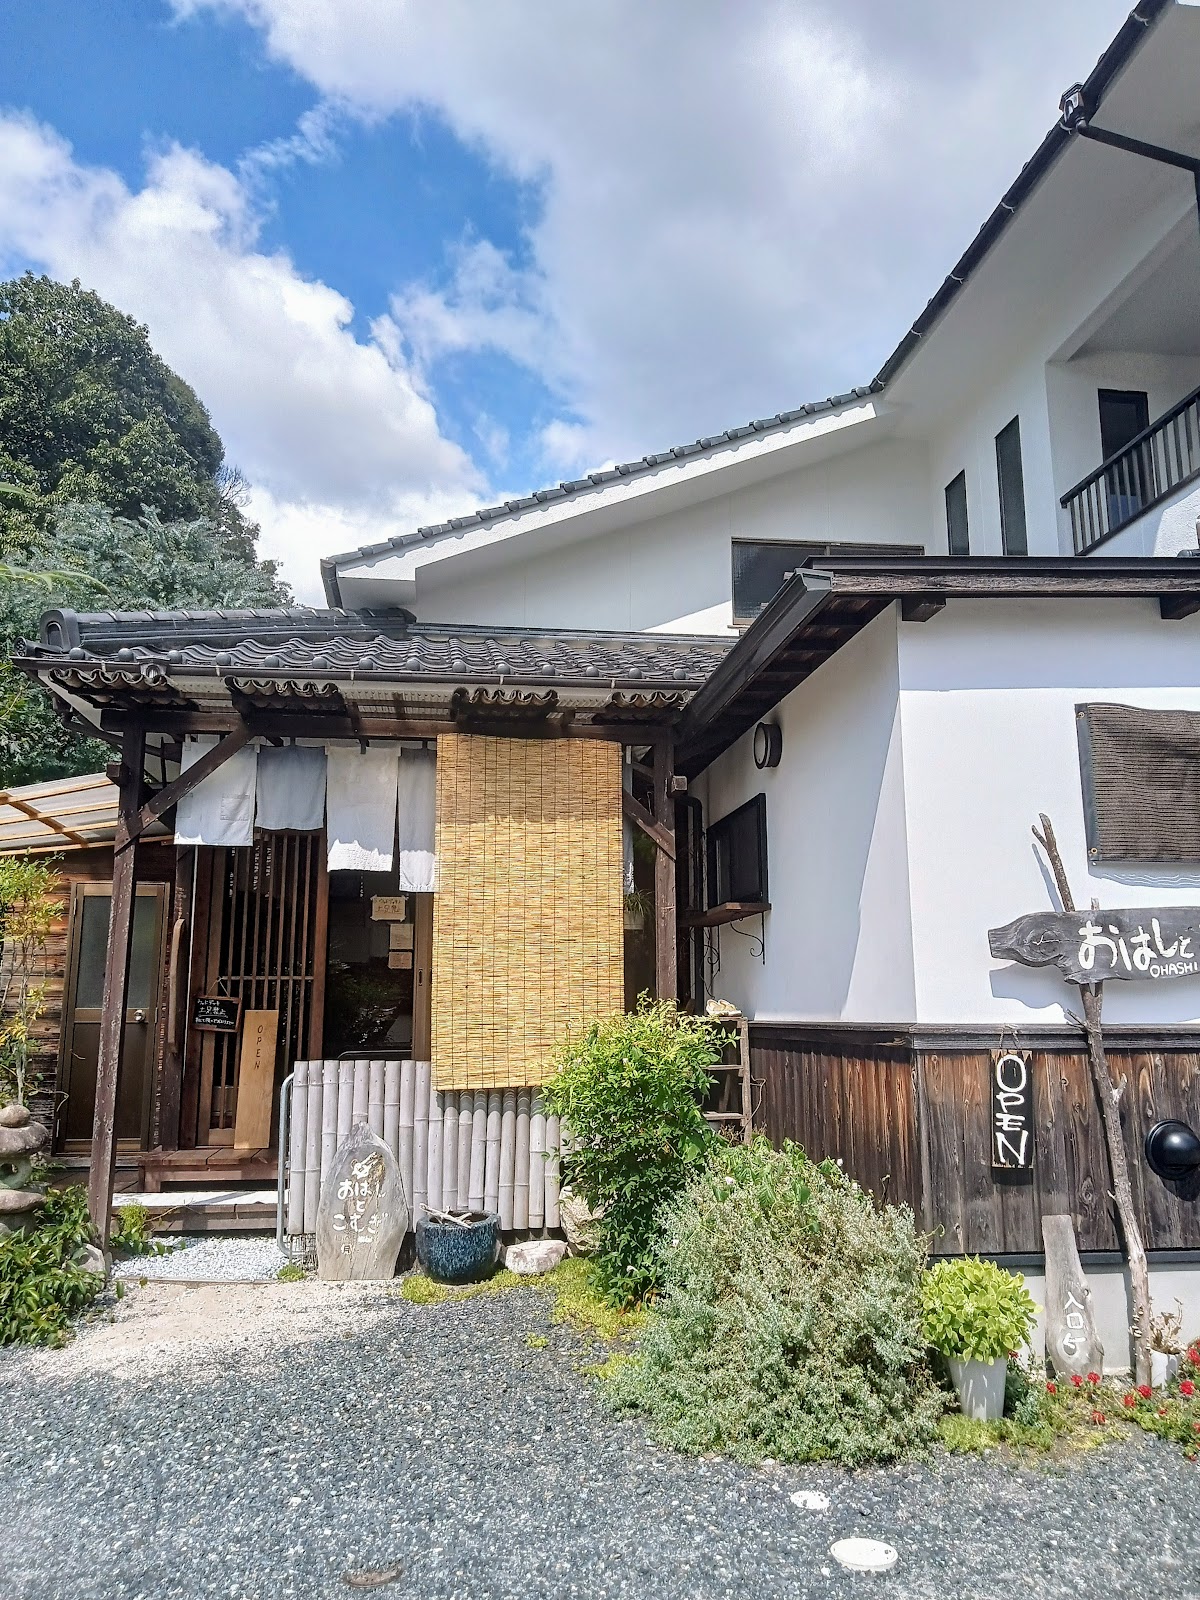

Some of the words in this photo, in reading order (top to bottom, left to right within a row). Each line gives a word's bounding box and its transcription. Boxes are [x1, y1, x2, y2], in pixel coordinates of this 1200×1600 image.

[1078, 917, 1195, 971] おはしと
[1149, 961, 1198, 978] OHASHI
[254, 1025, 264, 1070] OPEN
[995, 1054, 1030, 1165] OPEN
[337, 1179, 387, 1200] おはし
[356, 1200, 366, 1213] と
[333, 1212, 389, 1234] こむぎ
[1064, 1291, 1085, 1329] 入口
